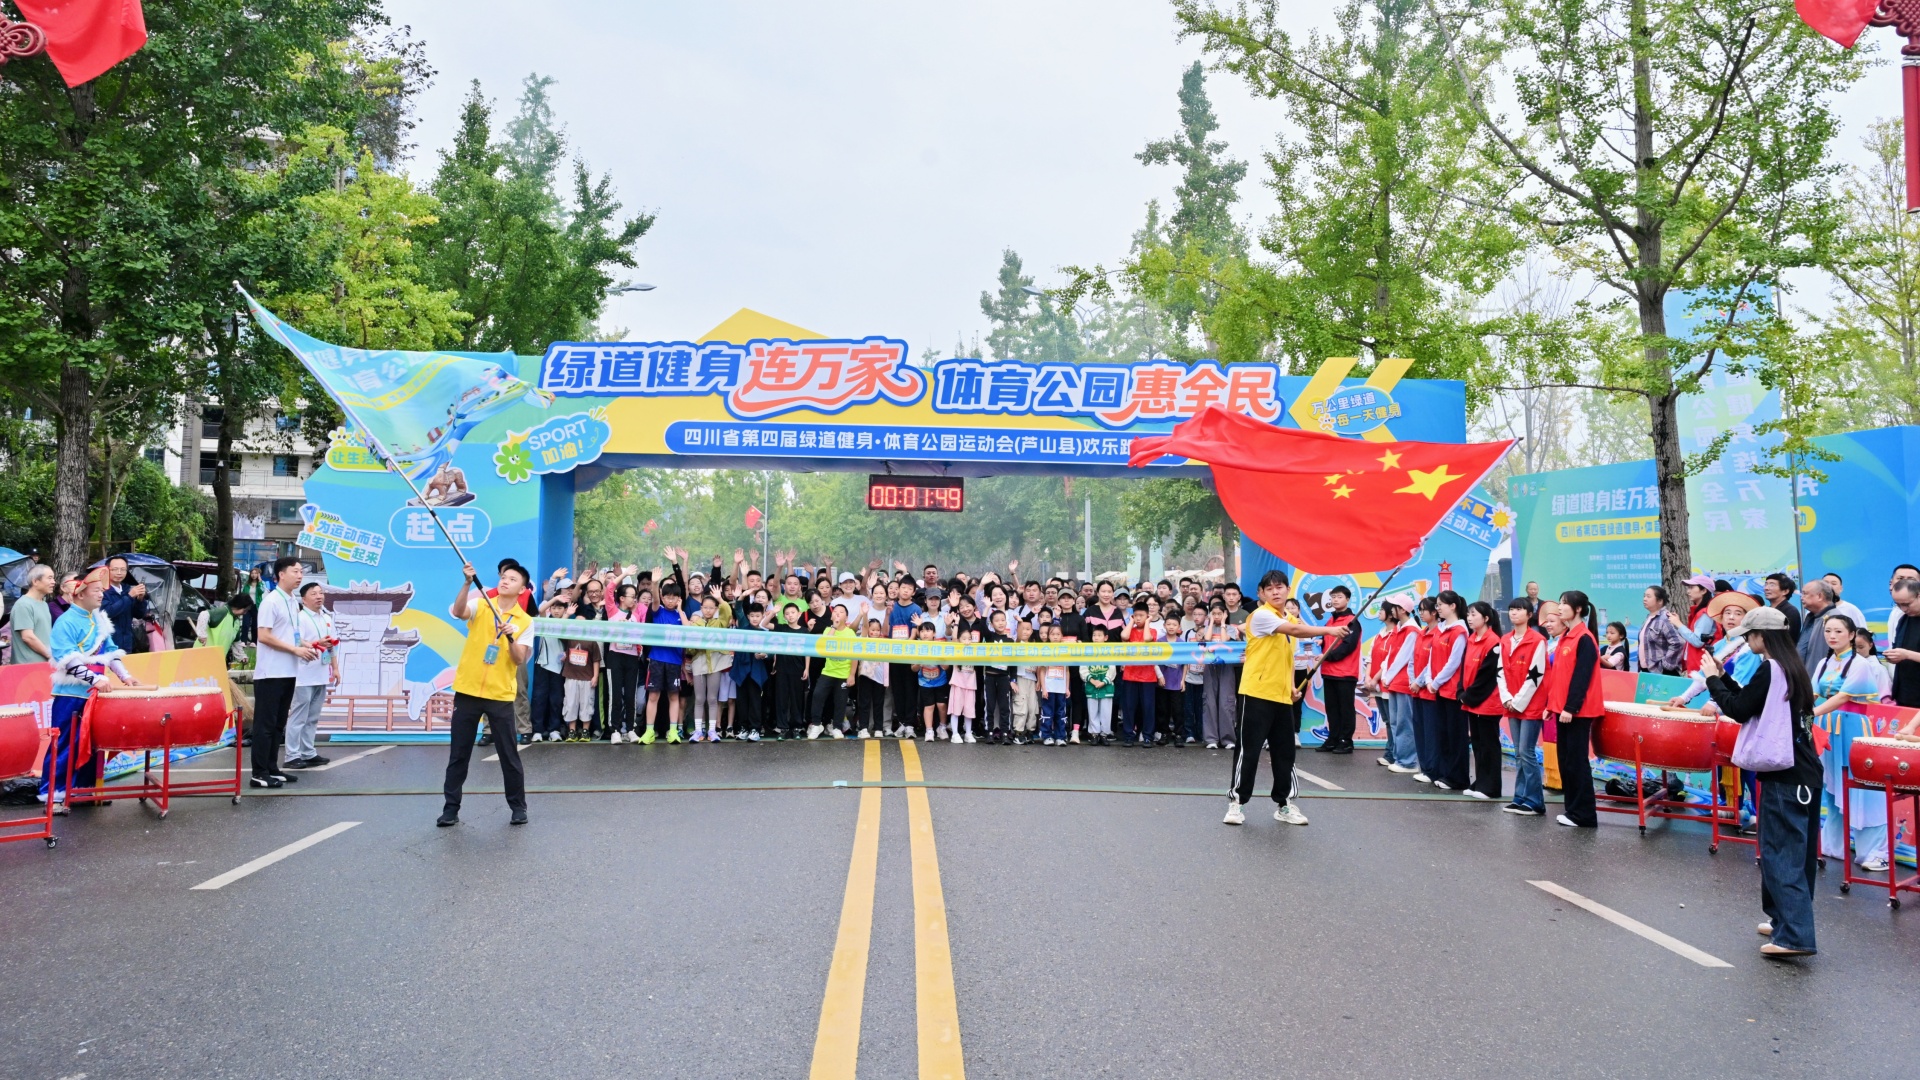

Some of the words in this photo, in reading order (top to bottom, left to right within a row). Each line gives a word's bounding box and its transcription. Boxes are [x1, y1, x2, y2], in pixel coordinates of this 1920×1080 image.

[548, 344, 908, 402] 绿道健身连万家
[937, 366, 1276, 420] 体育公园惠全民
[1311, 391, 1376, 415] 万公里绿道
[1336, 402, 1402, 428] 每一天健身
[528, 418, 588, 451] SPORT
[684, 427, 1173, 457] 四川省第四届绿道健身·体育公园运动会(芦山县)欢乐跑
[542, 443, 584, 467] 加油!
[871, 485, 961, 509] 00:01:49
[1551, 487, 1660, 516] 绿道健身连万家
[316, 520, 385, 550] 为运动而生
[406, 513, 474, 543] 起点
[298, 531, 380, 565] 热爱就一起来
[664, 629, 806, 653] 体育公园惠全民
